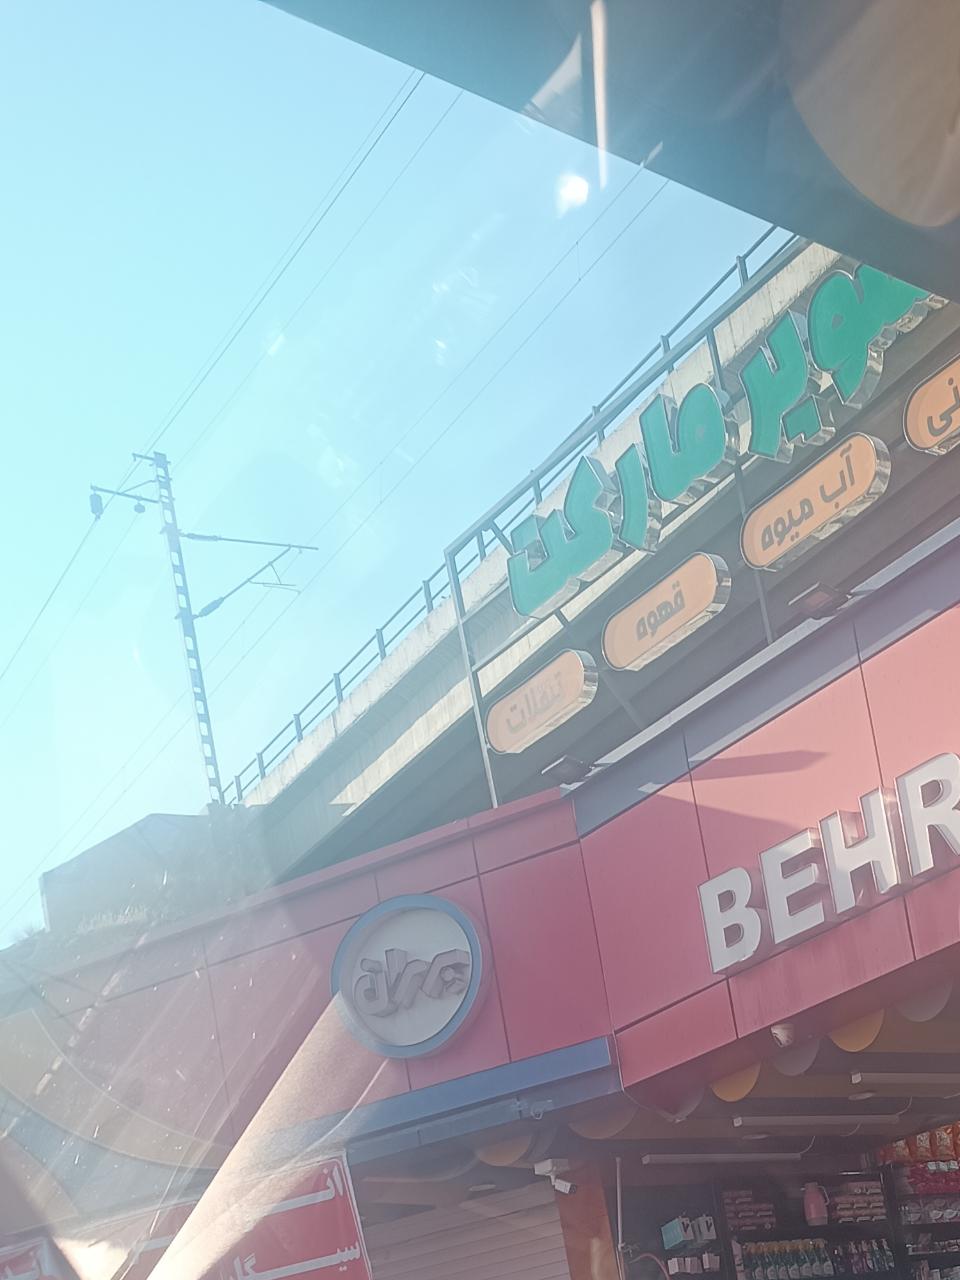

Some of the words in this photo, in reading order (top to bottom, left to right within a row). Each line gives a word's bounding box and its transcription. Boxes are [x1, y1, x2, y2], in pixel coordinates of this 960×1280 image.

[820, 449, 855, 509] آب
[761, 495, 815, 552] میوه
[636, 580, 686, 642] قهوه
